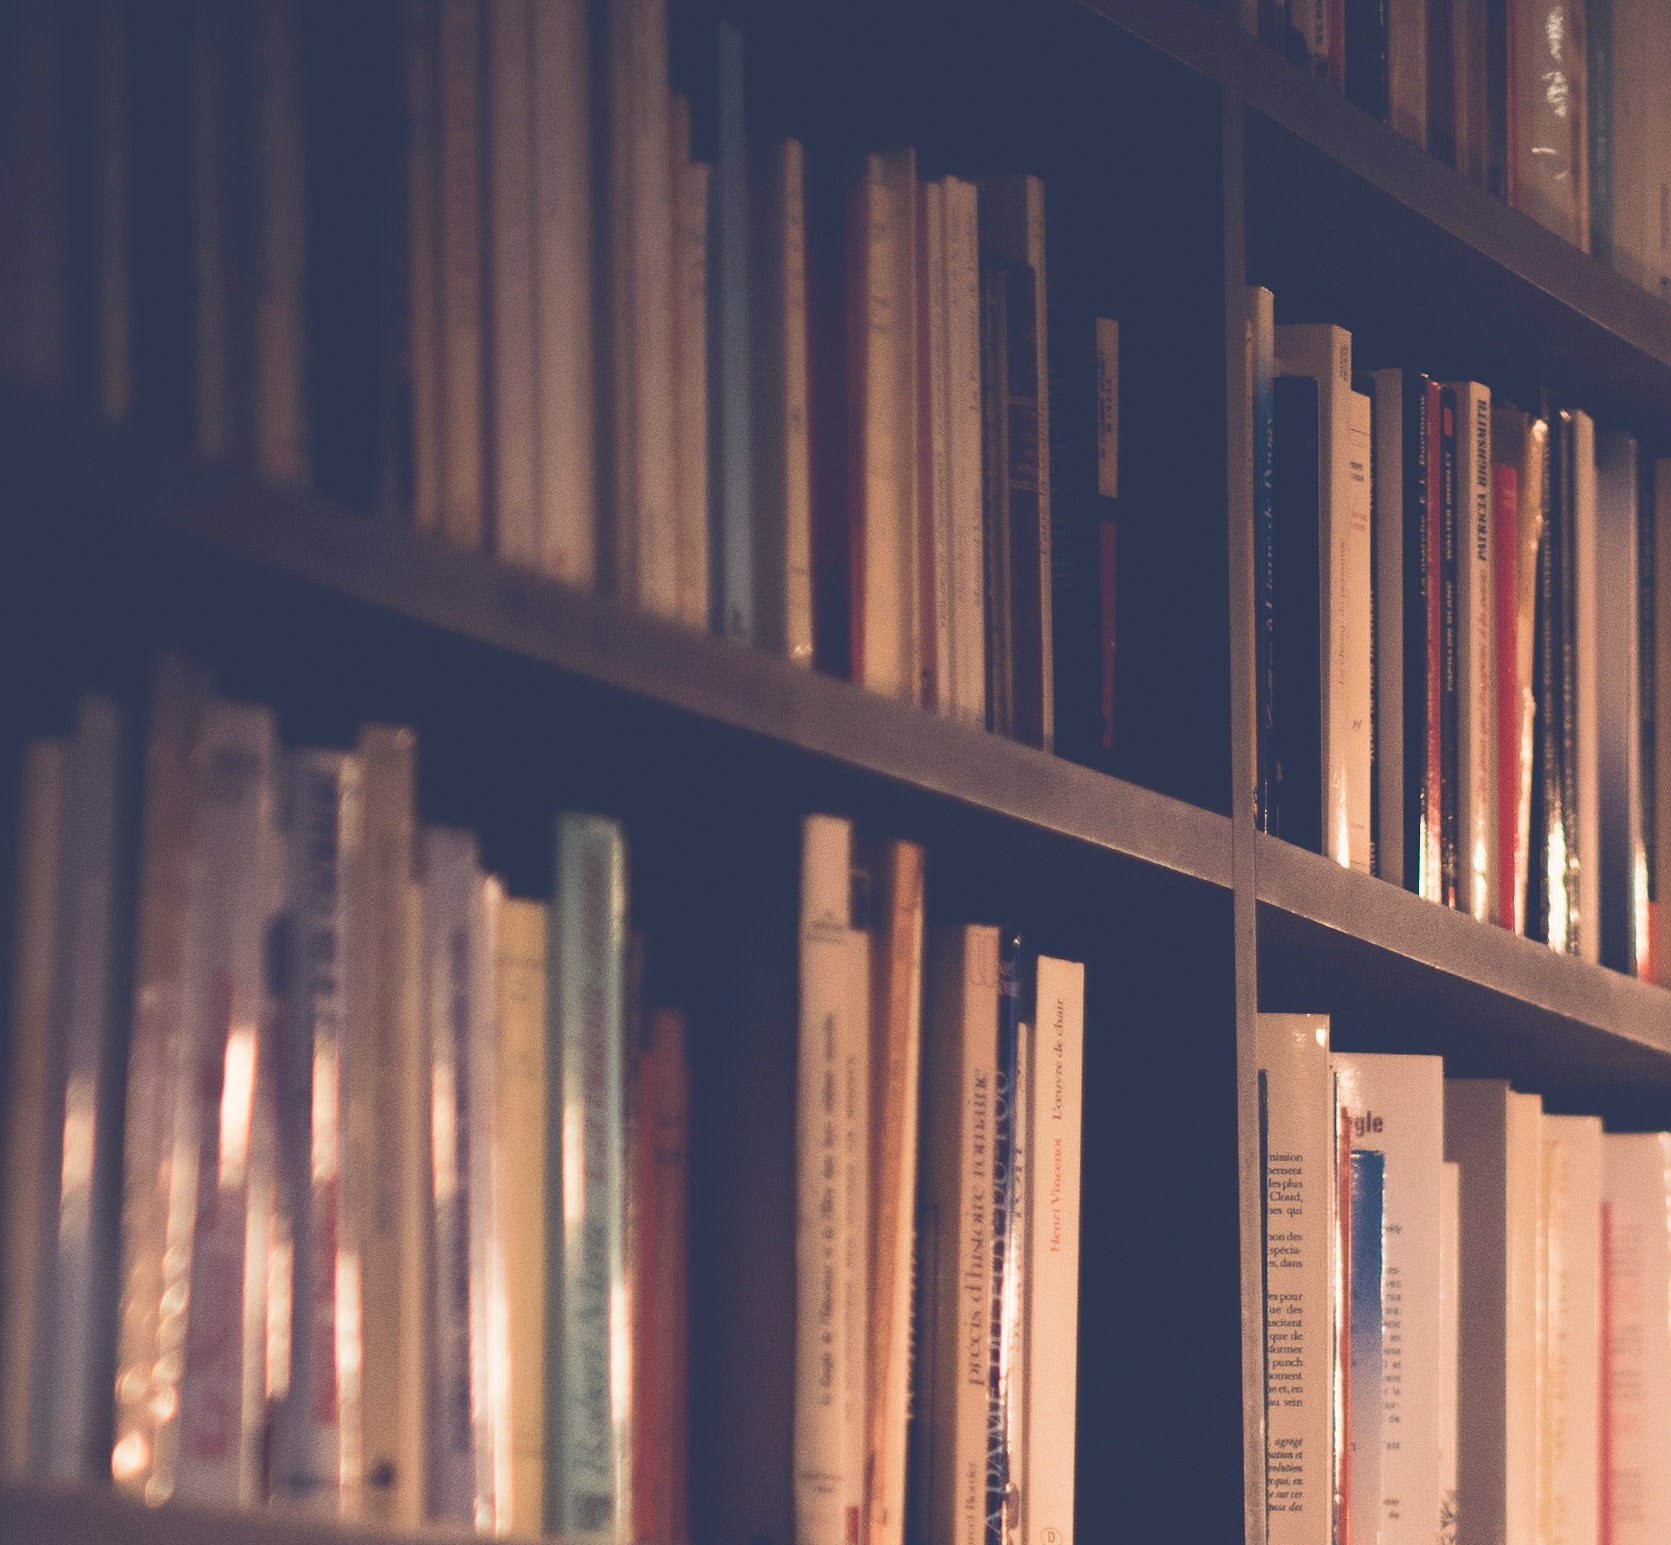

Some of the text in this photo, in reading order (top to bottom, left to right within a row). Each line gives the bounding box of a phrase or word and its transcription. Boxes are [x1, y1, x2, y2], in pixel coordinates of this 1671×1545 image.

[1477, 399, 1487, 561] PATRICIA HIGHSMITH
[1053, 998, 1064, 1037] chair
[1053, 1041, 1063, 1058] de
[966, 1067, 988, 1179] romaine
[1050, 1138, 1062, 1205] Vincenot
[1269, 1191, 1303, 1203] Cloud,
[1286, 1206, 1303, 1218] qui
[1050, 1208, 1061, 1252] Henri
[1286, 1231, 1303, 1241] des
[1279, 1257, 1303, 1268] dans
[1279, 1293, 1303, 1303] pour
[1286, 1304, 1303, 1314] des
[1269, 1333, 1288, 1343] que
[965, 1310, 985, 1387] précis
[1272, 1357, 1303, 1369] punch
